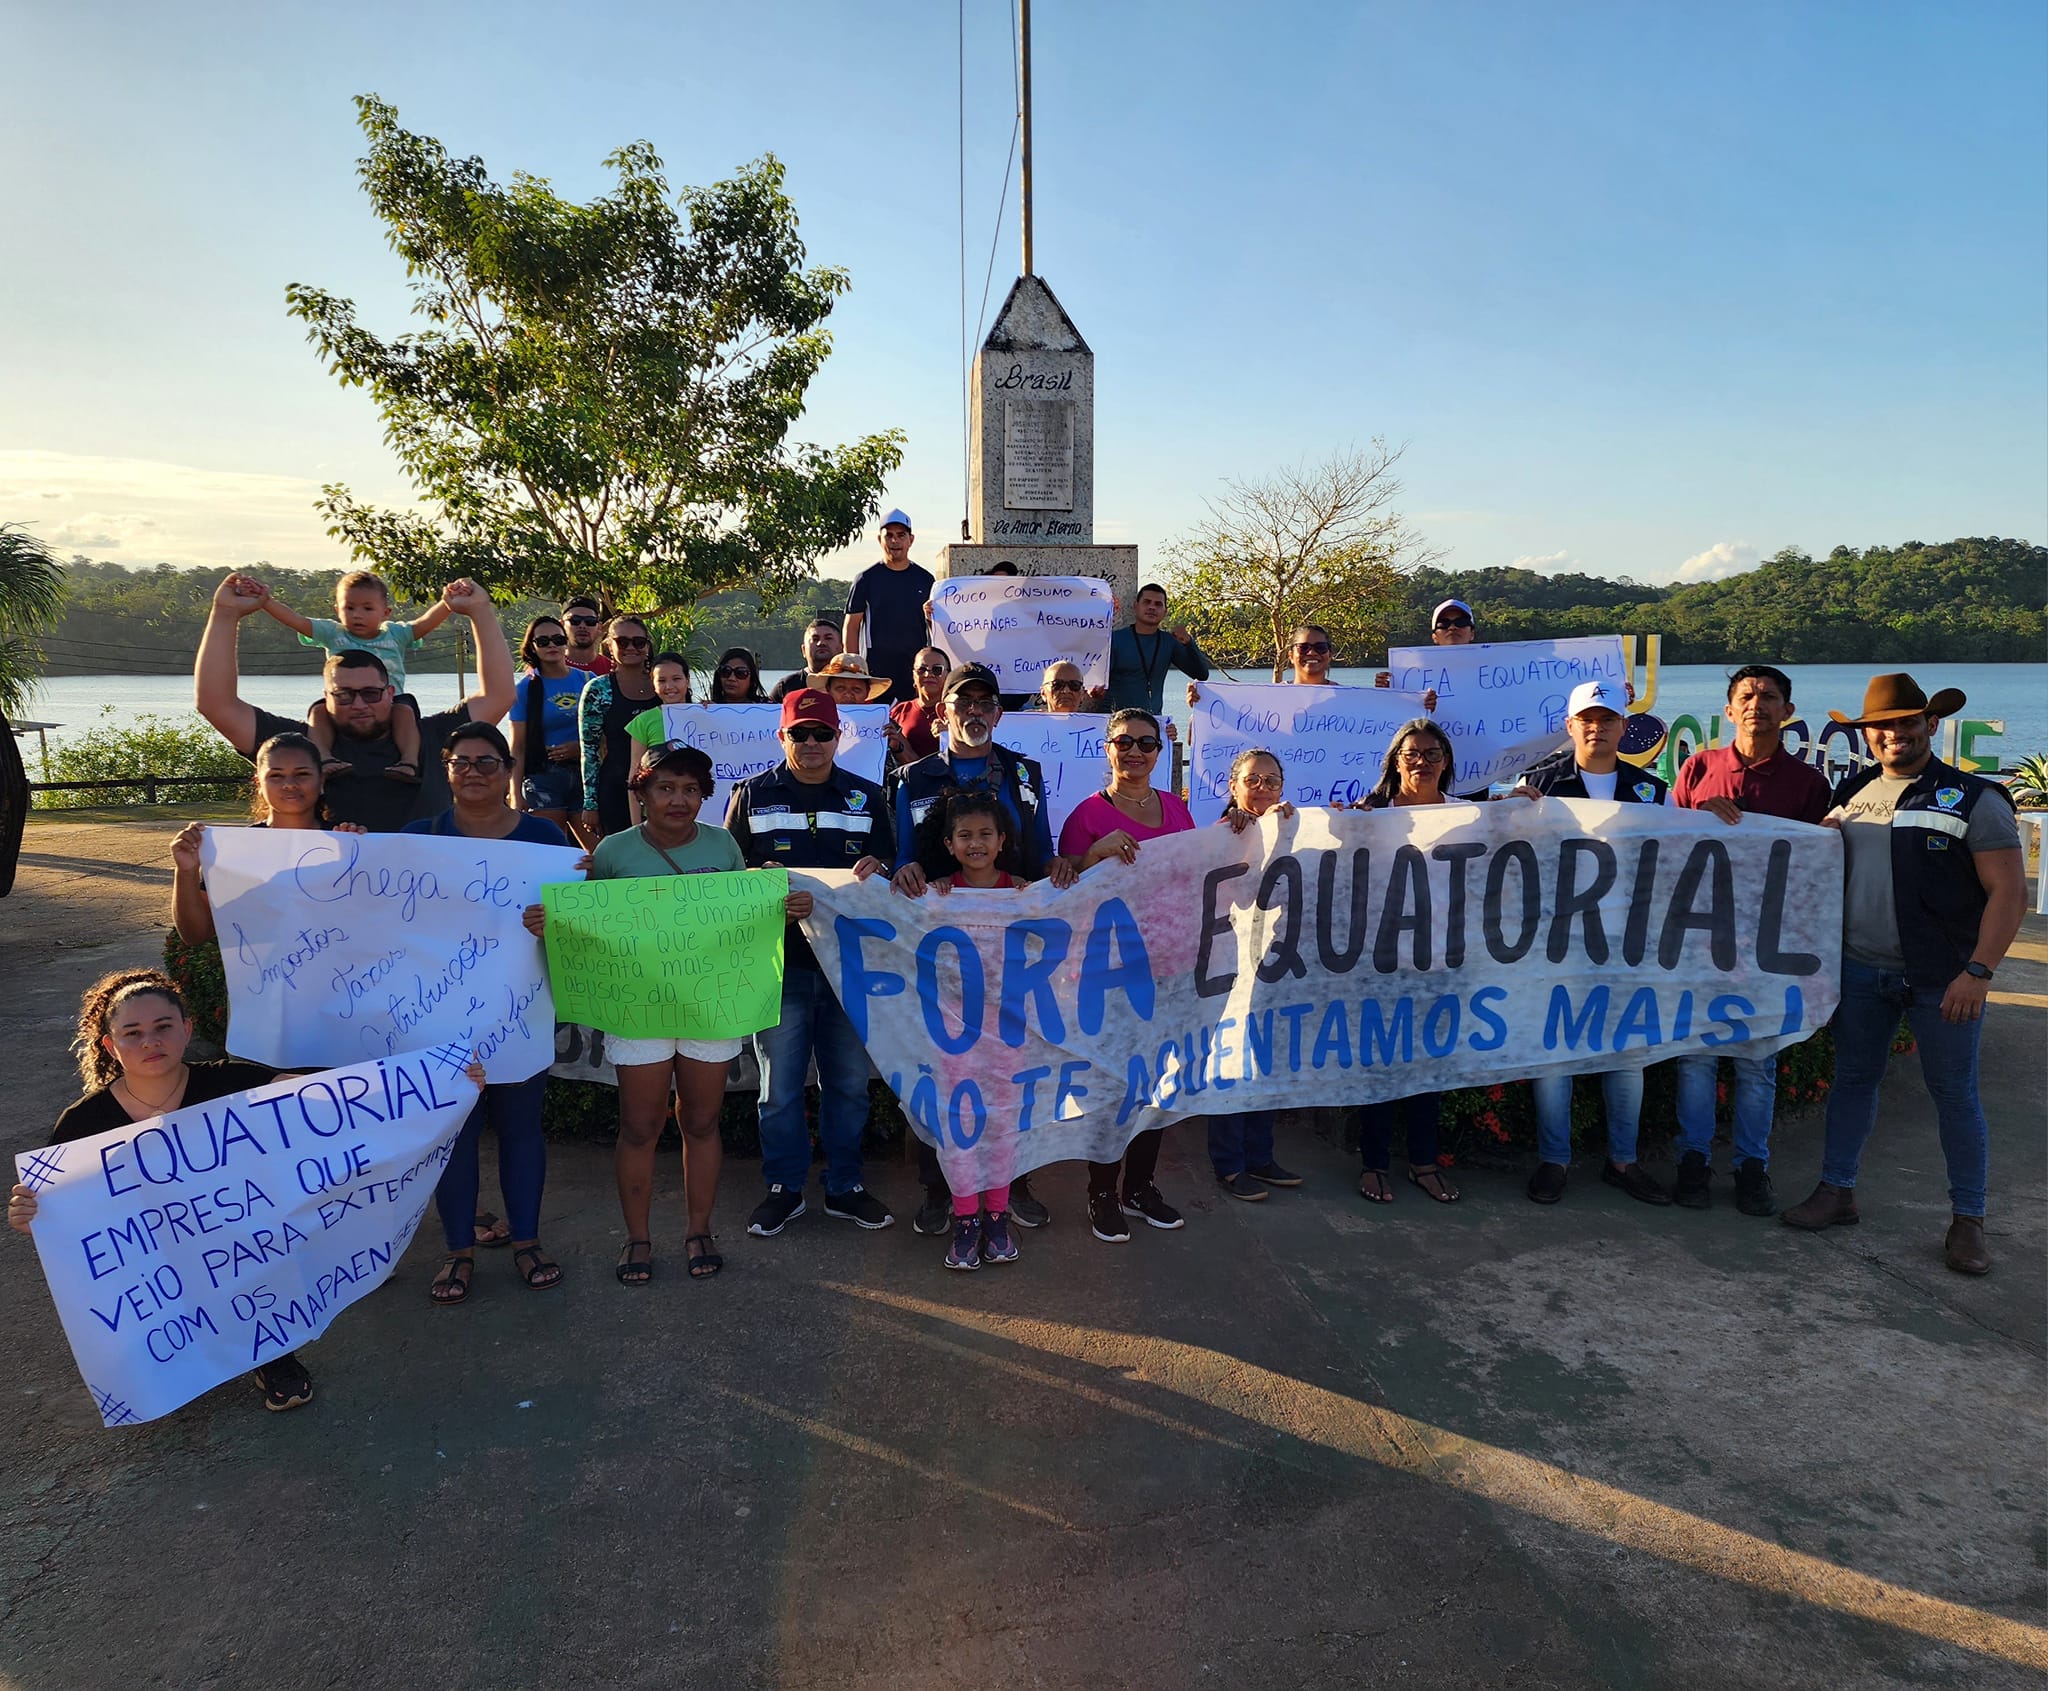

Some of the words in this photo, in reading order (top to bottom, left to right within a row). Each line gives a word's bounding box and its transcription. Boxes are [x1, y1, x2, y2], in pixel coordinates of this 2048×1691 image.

[994, 364, 1073, 390] Brasil
[993, 520, 1008, 535] De
[1010, 520, 1042, 535] Amor
[1046, 520, 1082, 535] Eterno
[943, 585, 987, 606] POUCO
[1004, 585, 1072, 598] CONSUMO
[1089, 587, 1098, 597] E
[947, 615, 1019, 635] COBRANÇAS
[1036, 610, 1111, 630] ABSURDAS!
[1478, 653, 1618, 690] EQUATORIAL
[1209, 699, 1225, 729] O
[1236, 704, 1281, 733] POVO
[1441, 718, 1486, 738] RGIA
[1500, 717, 1527, 733] DE
[684, 721, 780, 749] REPUDIAMO
[838, 720, 882, 741] BUSOS
[1041, 730, 1063, 754] de
[1201, 742, 1245, 760] ESTÁ
[715, 759, 780, 778] EQUATOR
[1298, 786, 1322, 803] DA
[1844, 800, 1876, 813] OHN
[294, 838, 449, 922] Chega
[551, 884, 609, 914] ISSO
[625, 878, 645, 905] é
[231, 921, 350, 996] Impostos
[834, 897, 1156, 1055] FORA
[1195, 837, 1822, 998] EQUATORIAL
[331, 948, 408, 1020] Taxas
[693, 970, 755, 1006] CEA
[465, 995, 486, 1017] e
[567, 992, 751, 1030] EQUATORIAL
[1012, 1061, 1092, 1132] TE
[1115, 985, 1508, 1126] AGUENTAMOS
[99, 1058, 458, 1198] EQUATORIAL
[80, 1178, 276, 1281] EMPRESA
[296, 1143, 372, 1196] QUE
[90, 1264, 184, 1333] VEIO
[201, 1221, 309, 1289] PARA
[146, 1306, 220, 1363] COM
[230, 1283, 279, 1322] OS
